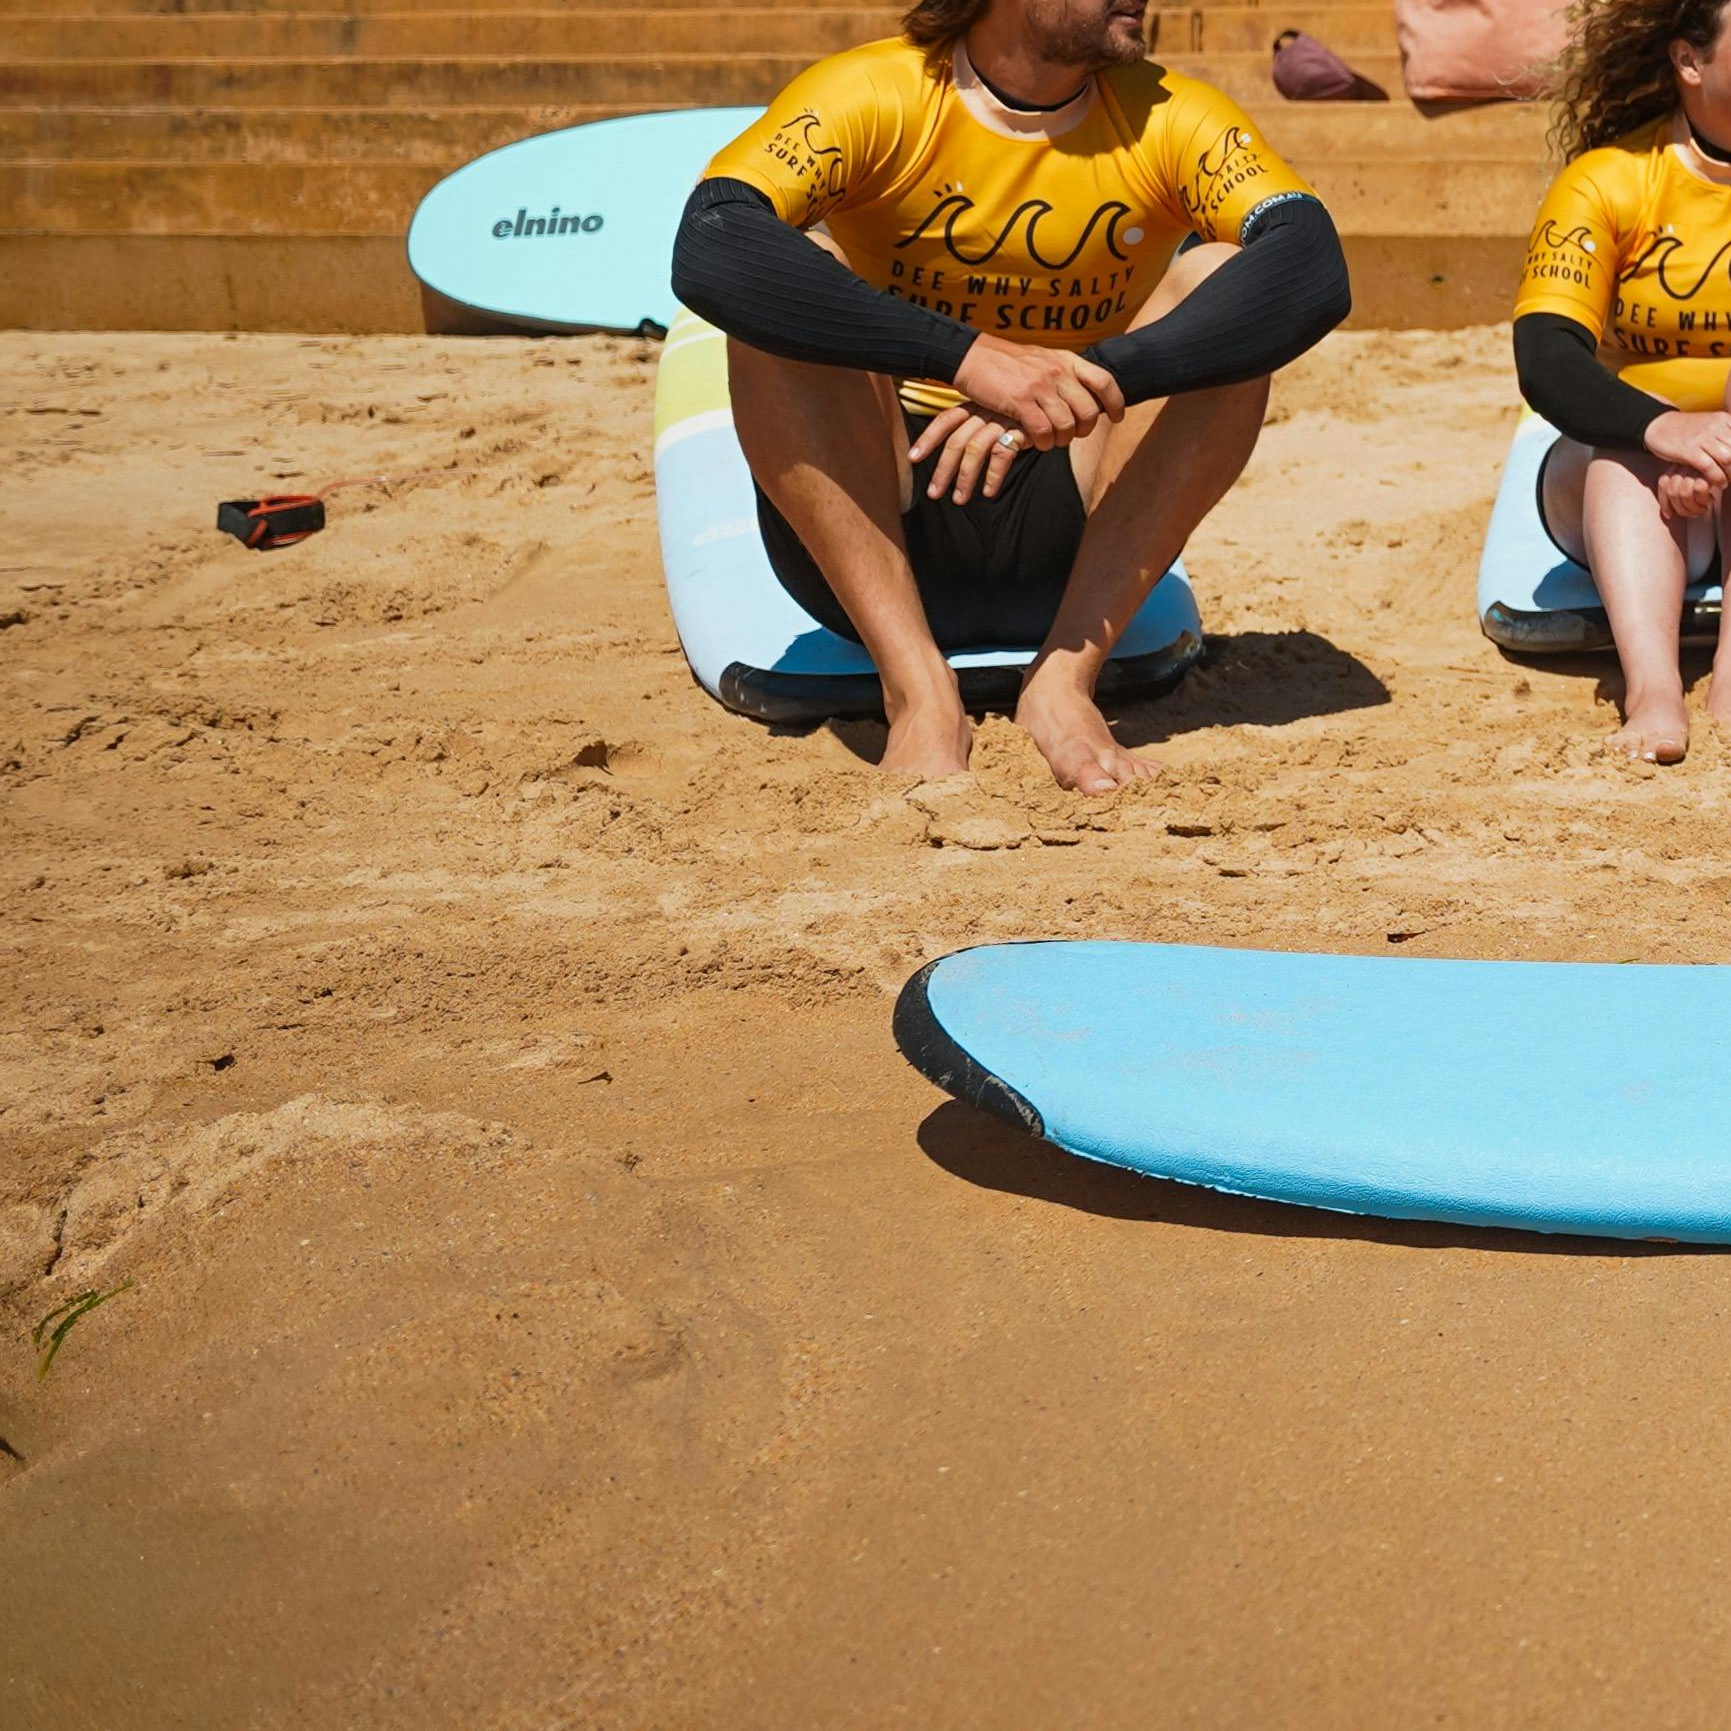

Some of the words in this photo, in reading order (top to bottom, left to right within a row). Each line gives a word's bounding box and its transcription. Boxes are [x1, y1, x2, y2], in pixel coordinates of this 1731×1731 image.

[764, 143, 808, 177] SURF
[1210, 164, 1270, 213] SCHOOL
[492, 207, 604, 238] elnino
[1552, 251, 1592, 270] SALTY
[891, 259, 945, 291] DEE
[966, 275, 1033, 297] WHY
[1050, 265, 1136, 297] SALTY
[1532, 265, 1591, 290] SCHOOL
[995, 291, 1127, 330] SCHOOL
[1614, 297, 1658, 328] DEE
